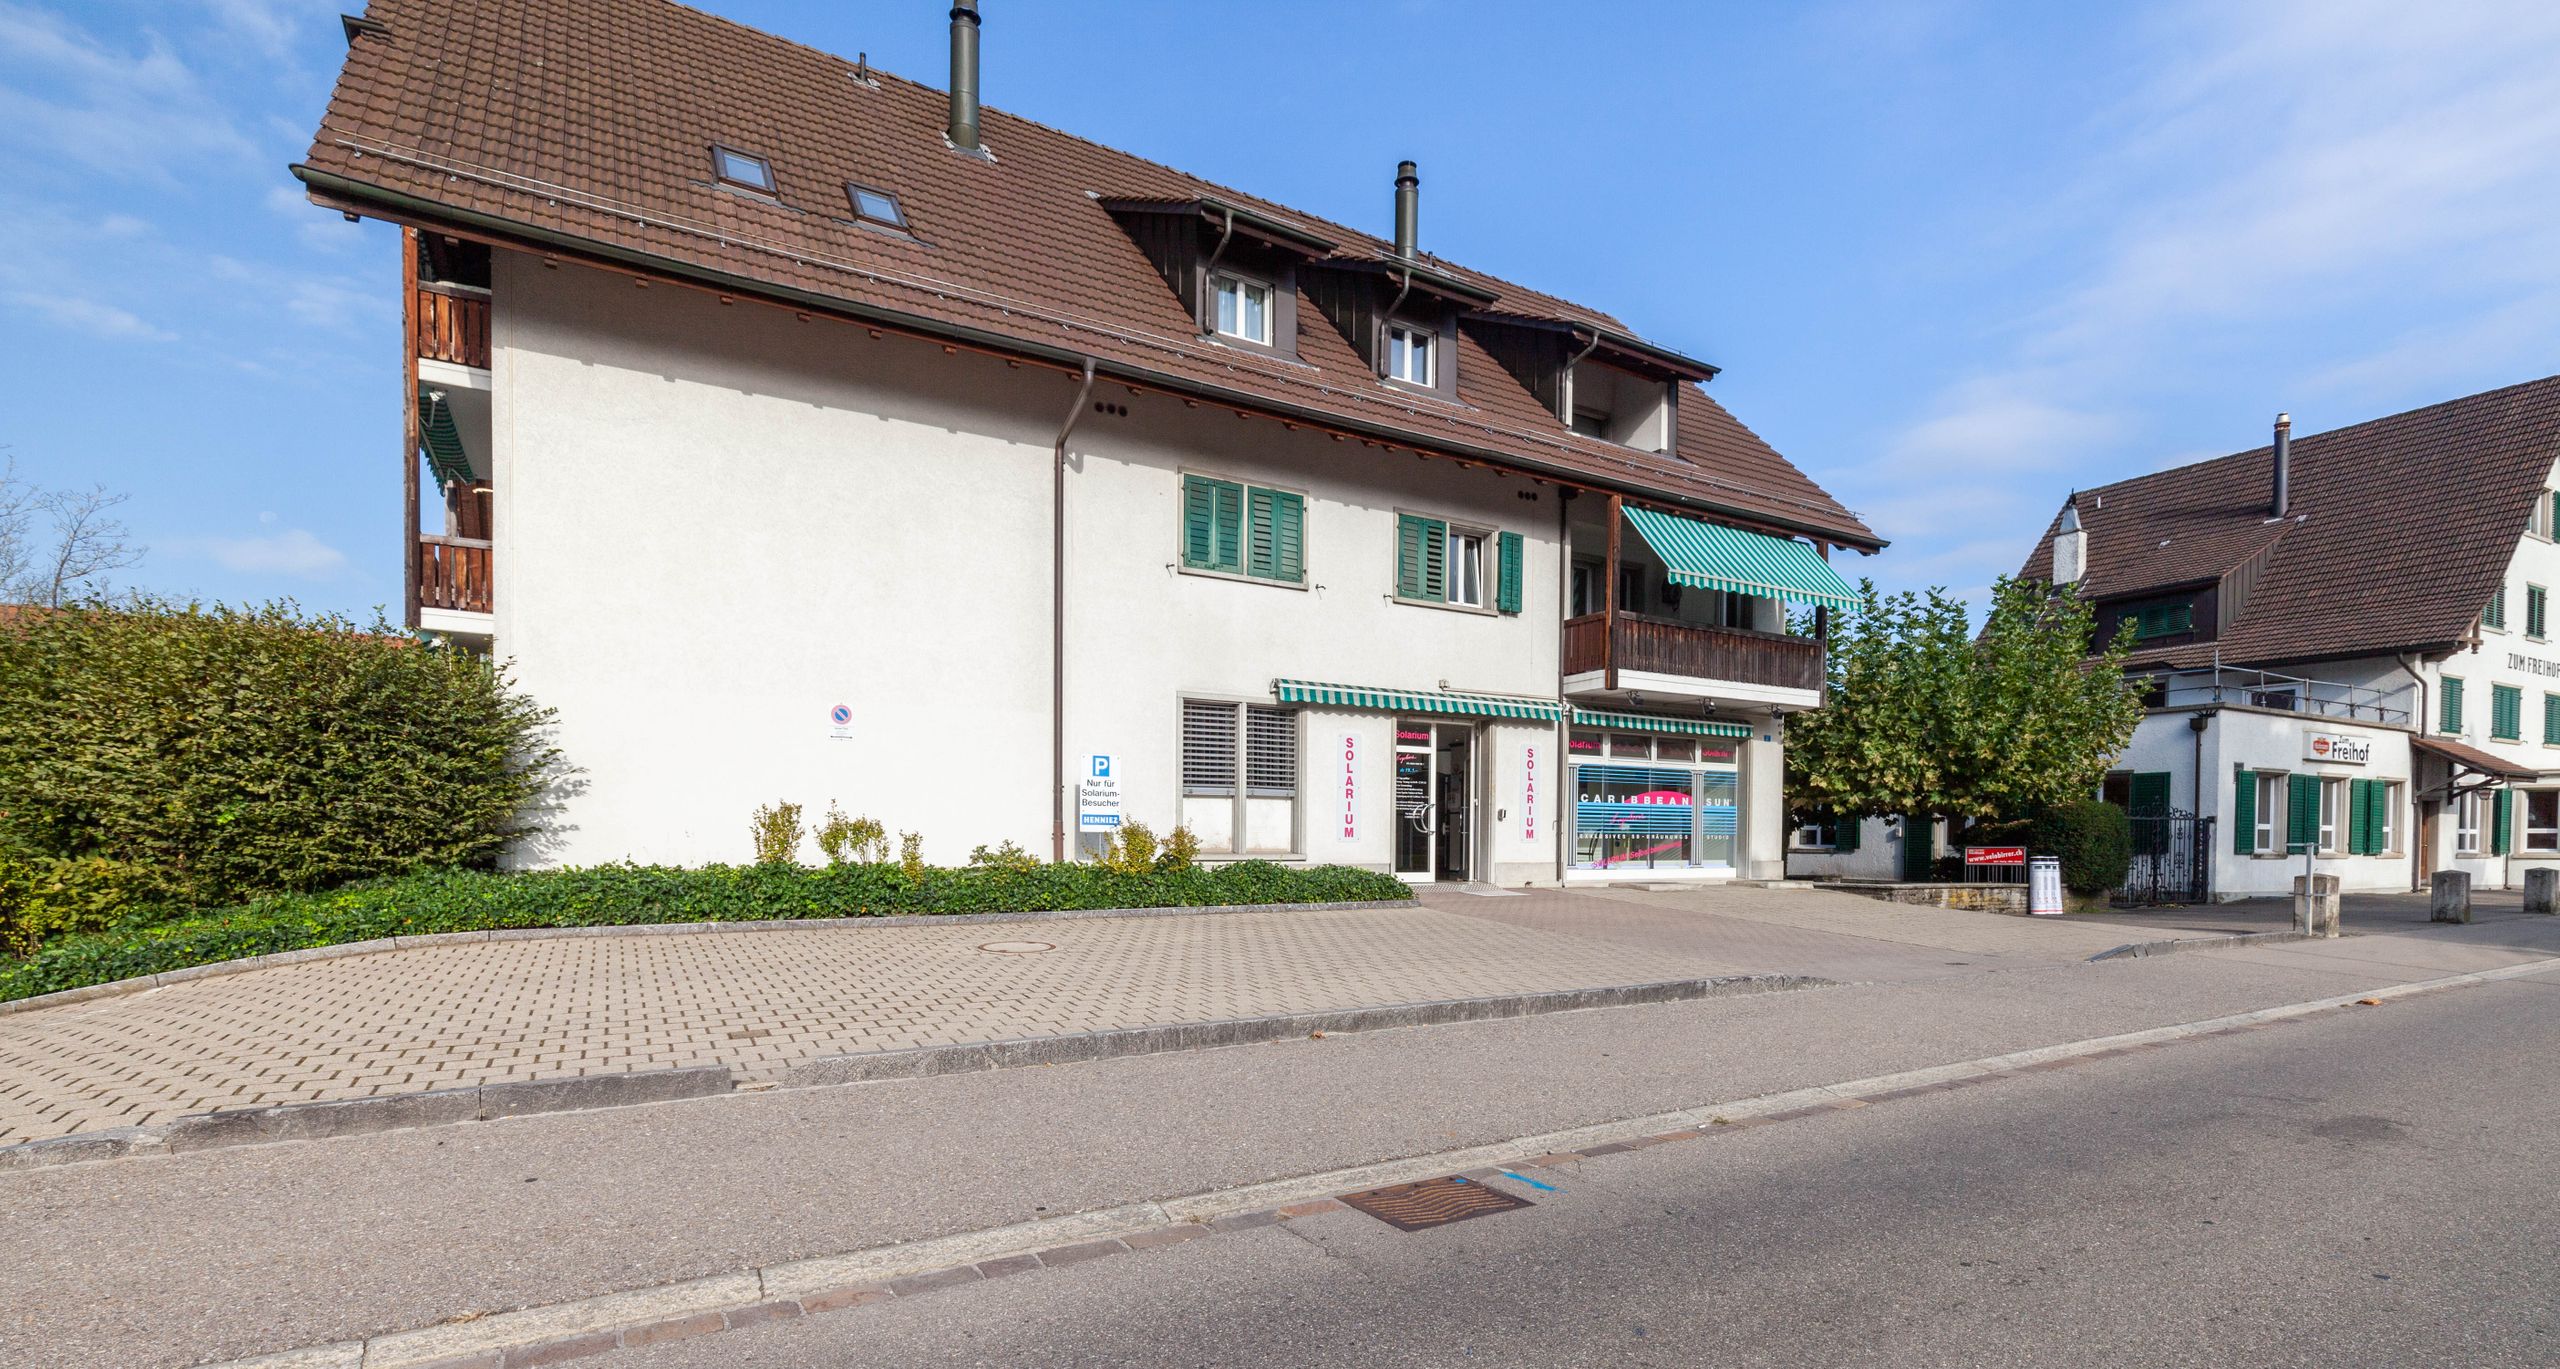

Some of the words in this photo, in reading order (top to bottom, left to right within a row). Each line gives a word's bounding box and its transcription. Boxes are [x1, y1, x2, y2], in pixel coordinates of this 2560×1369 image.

[2507, 653, 2526, 671] ZUM
[2527, 657, 2560, 678] FREIHOF
[2339, 735, 2350, 743] Zum
[2332, 741, 2370, 761] Freihof
[1095, 757, 1109, 776] P
[1087, 779, 1101, 787] Nur
[1104, 780, 1115, 788] für
[1344, 737, 1354, 838] SOLARIUM
[1081, 788, 1120, 797] Solarium-
[1526, 748, 1534, 839] SOLARIUM
[1082, 798, 1120, 807] Besucher
[1580, 793, 1689, 806] CARIBBEAN
[1083, 816, 1118, 824] HENNIEZ
